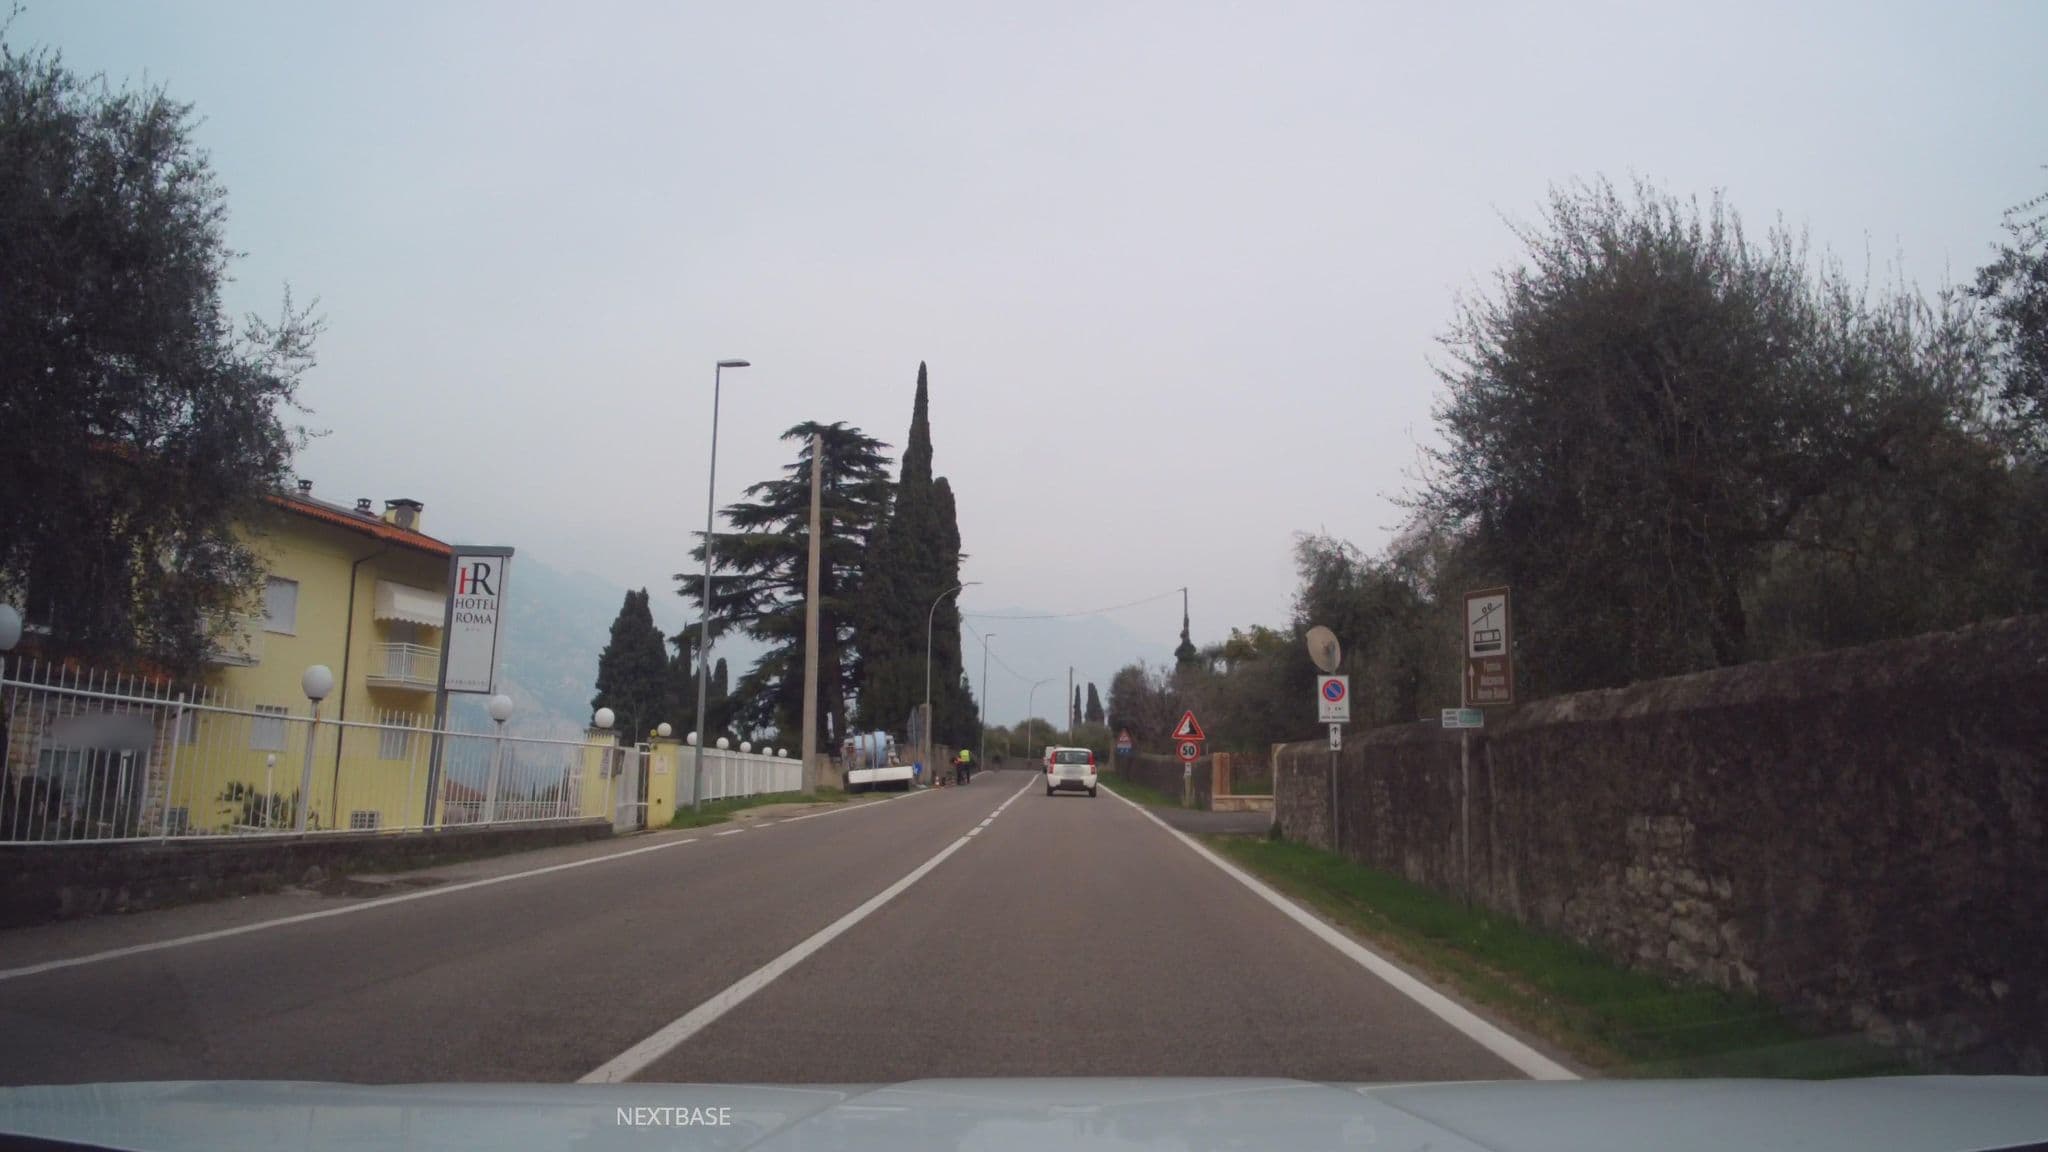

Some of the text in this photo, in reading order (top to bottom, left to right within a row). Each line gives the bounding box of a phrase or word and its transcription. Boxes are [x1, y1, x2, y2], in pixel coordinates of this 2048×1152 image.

[455, 598, 496, 610] HOTEL
[456, 612, 492, 624] ROMA
[1182, 745, 1195, 756] 50
